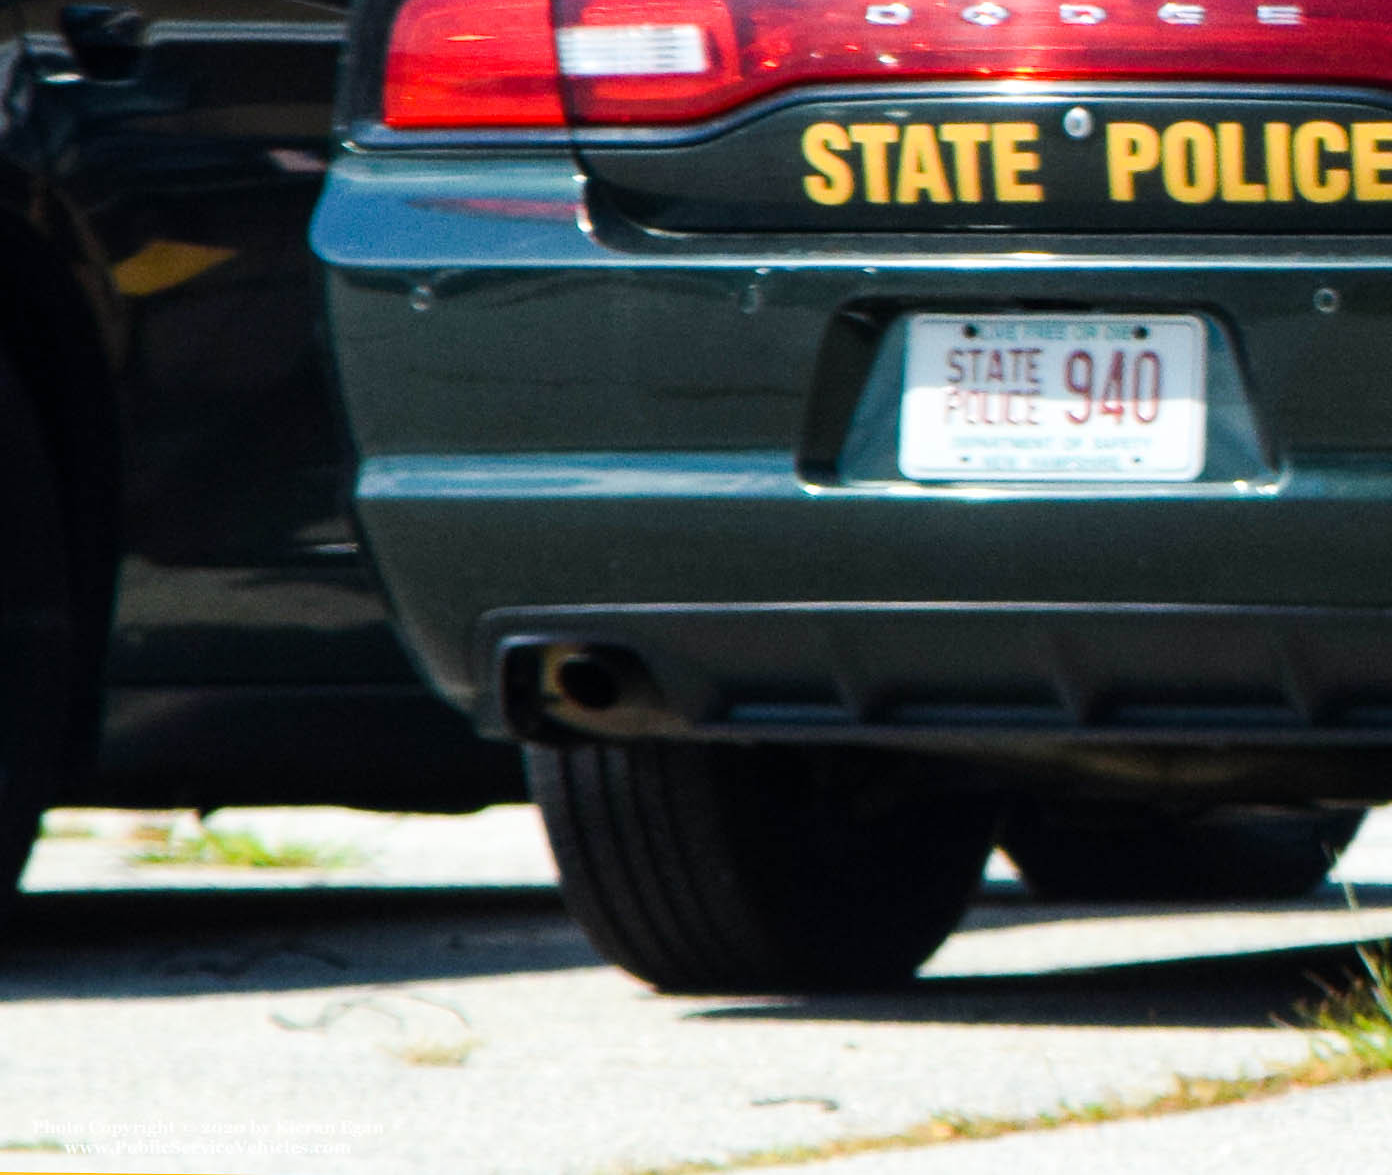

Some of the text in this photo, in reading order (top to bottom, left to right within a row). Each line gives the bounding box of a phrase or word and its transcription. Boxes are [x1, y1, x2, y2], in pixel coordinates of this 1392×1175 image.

[865, 2, 1303, 26] DODGE
[802, 122, 1044, 206] STATE
[946, 348, 1042, 383] STATE
[1065, 349, 1161, 424] 940
[945, 390, 1041, 425] POLICE
